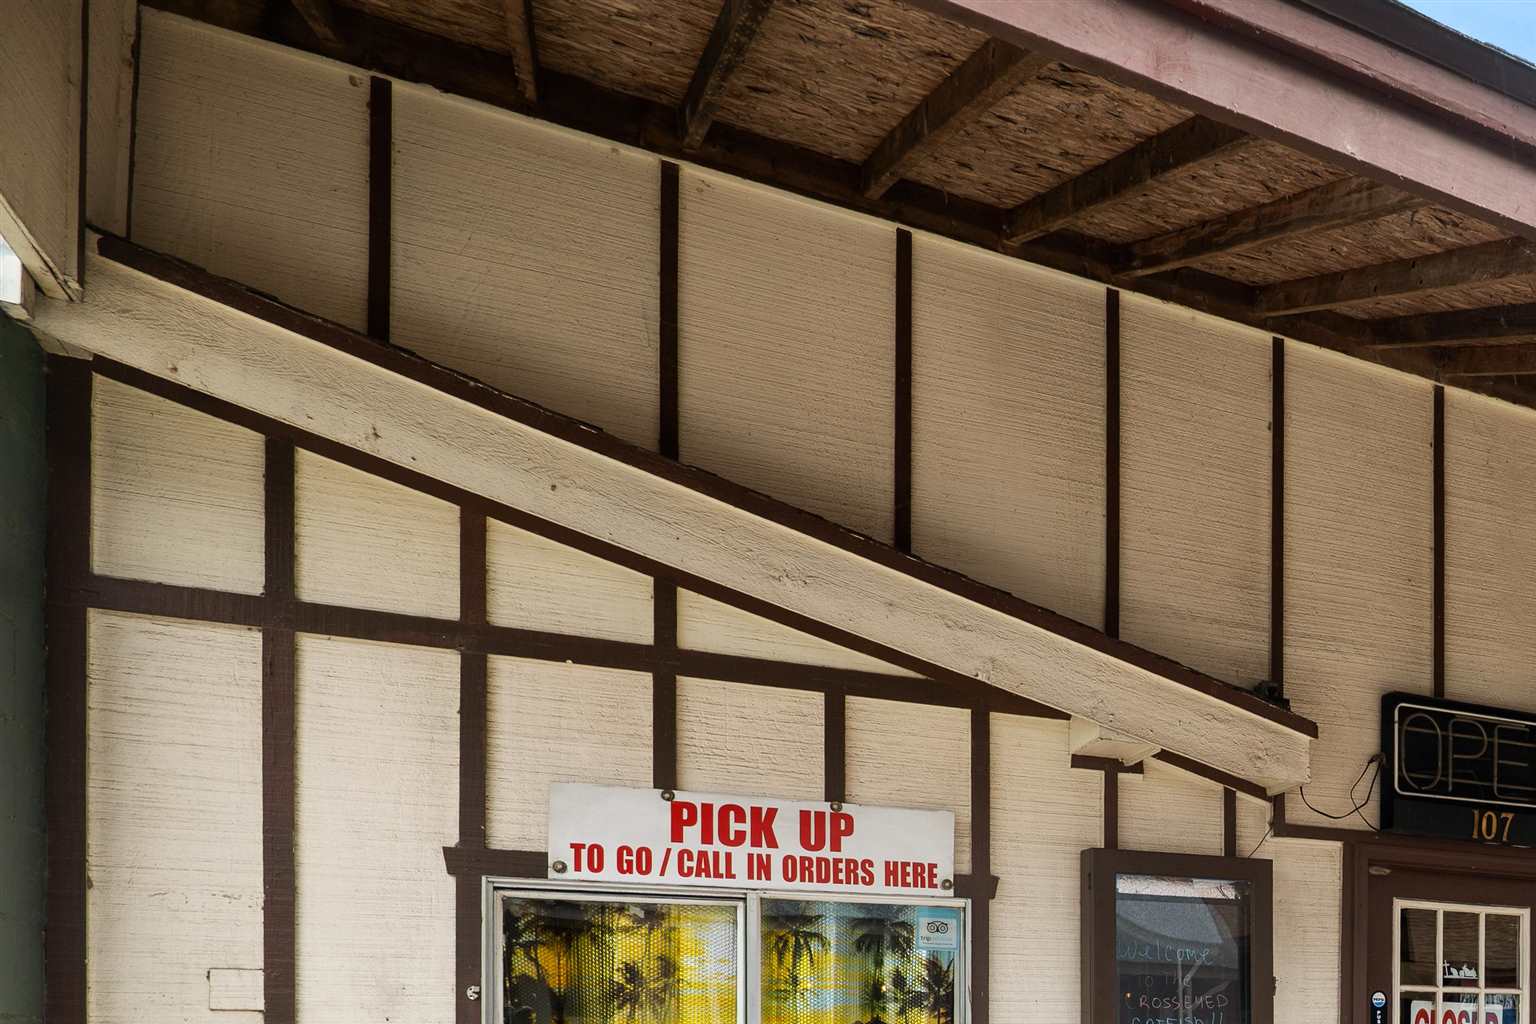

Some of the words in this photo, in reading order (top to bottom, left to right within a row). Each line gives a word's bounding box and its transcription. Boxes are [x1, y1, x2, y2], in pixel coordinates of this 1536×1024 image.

[670, 800, 779, 849] PICK
[800, 809, 855, 852] UP
[1472, 810, 1516, 842] 107
[570, 842, 605, 873] TO
[617, 845, 653, 876] GO
[677, 848, 737, 880] CALL
[747, 852, 772, 881] IN
[782, 853, 875, 887] ORDERS
[885, 860, 939, 889] HERE
